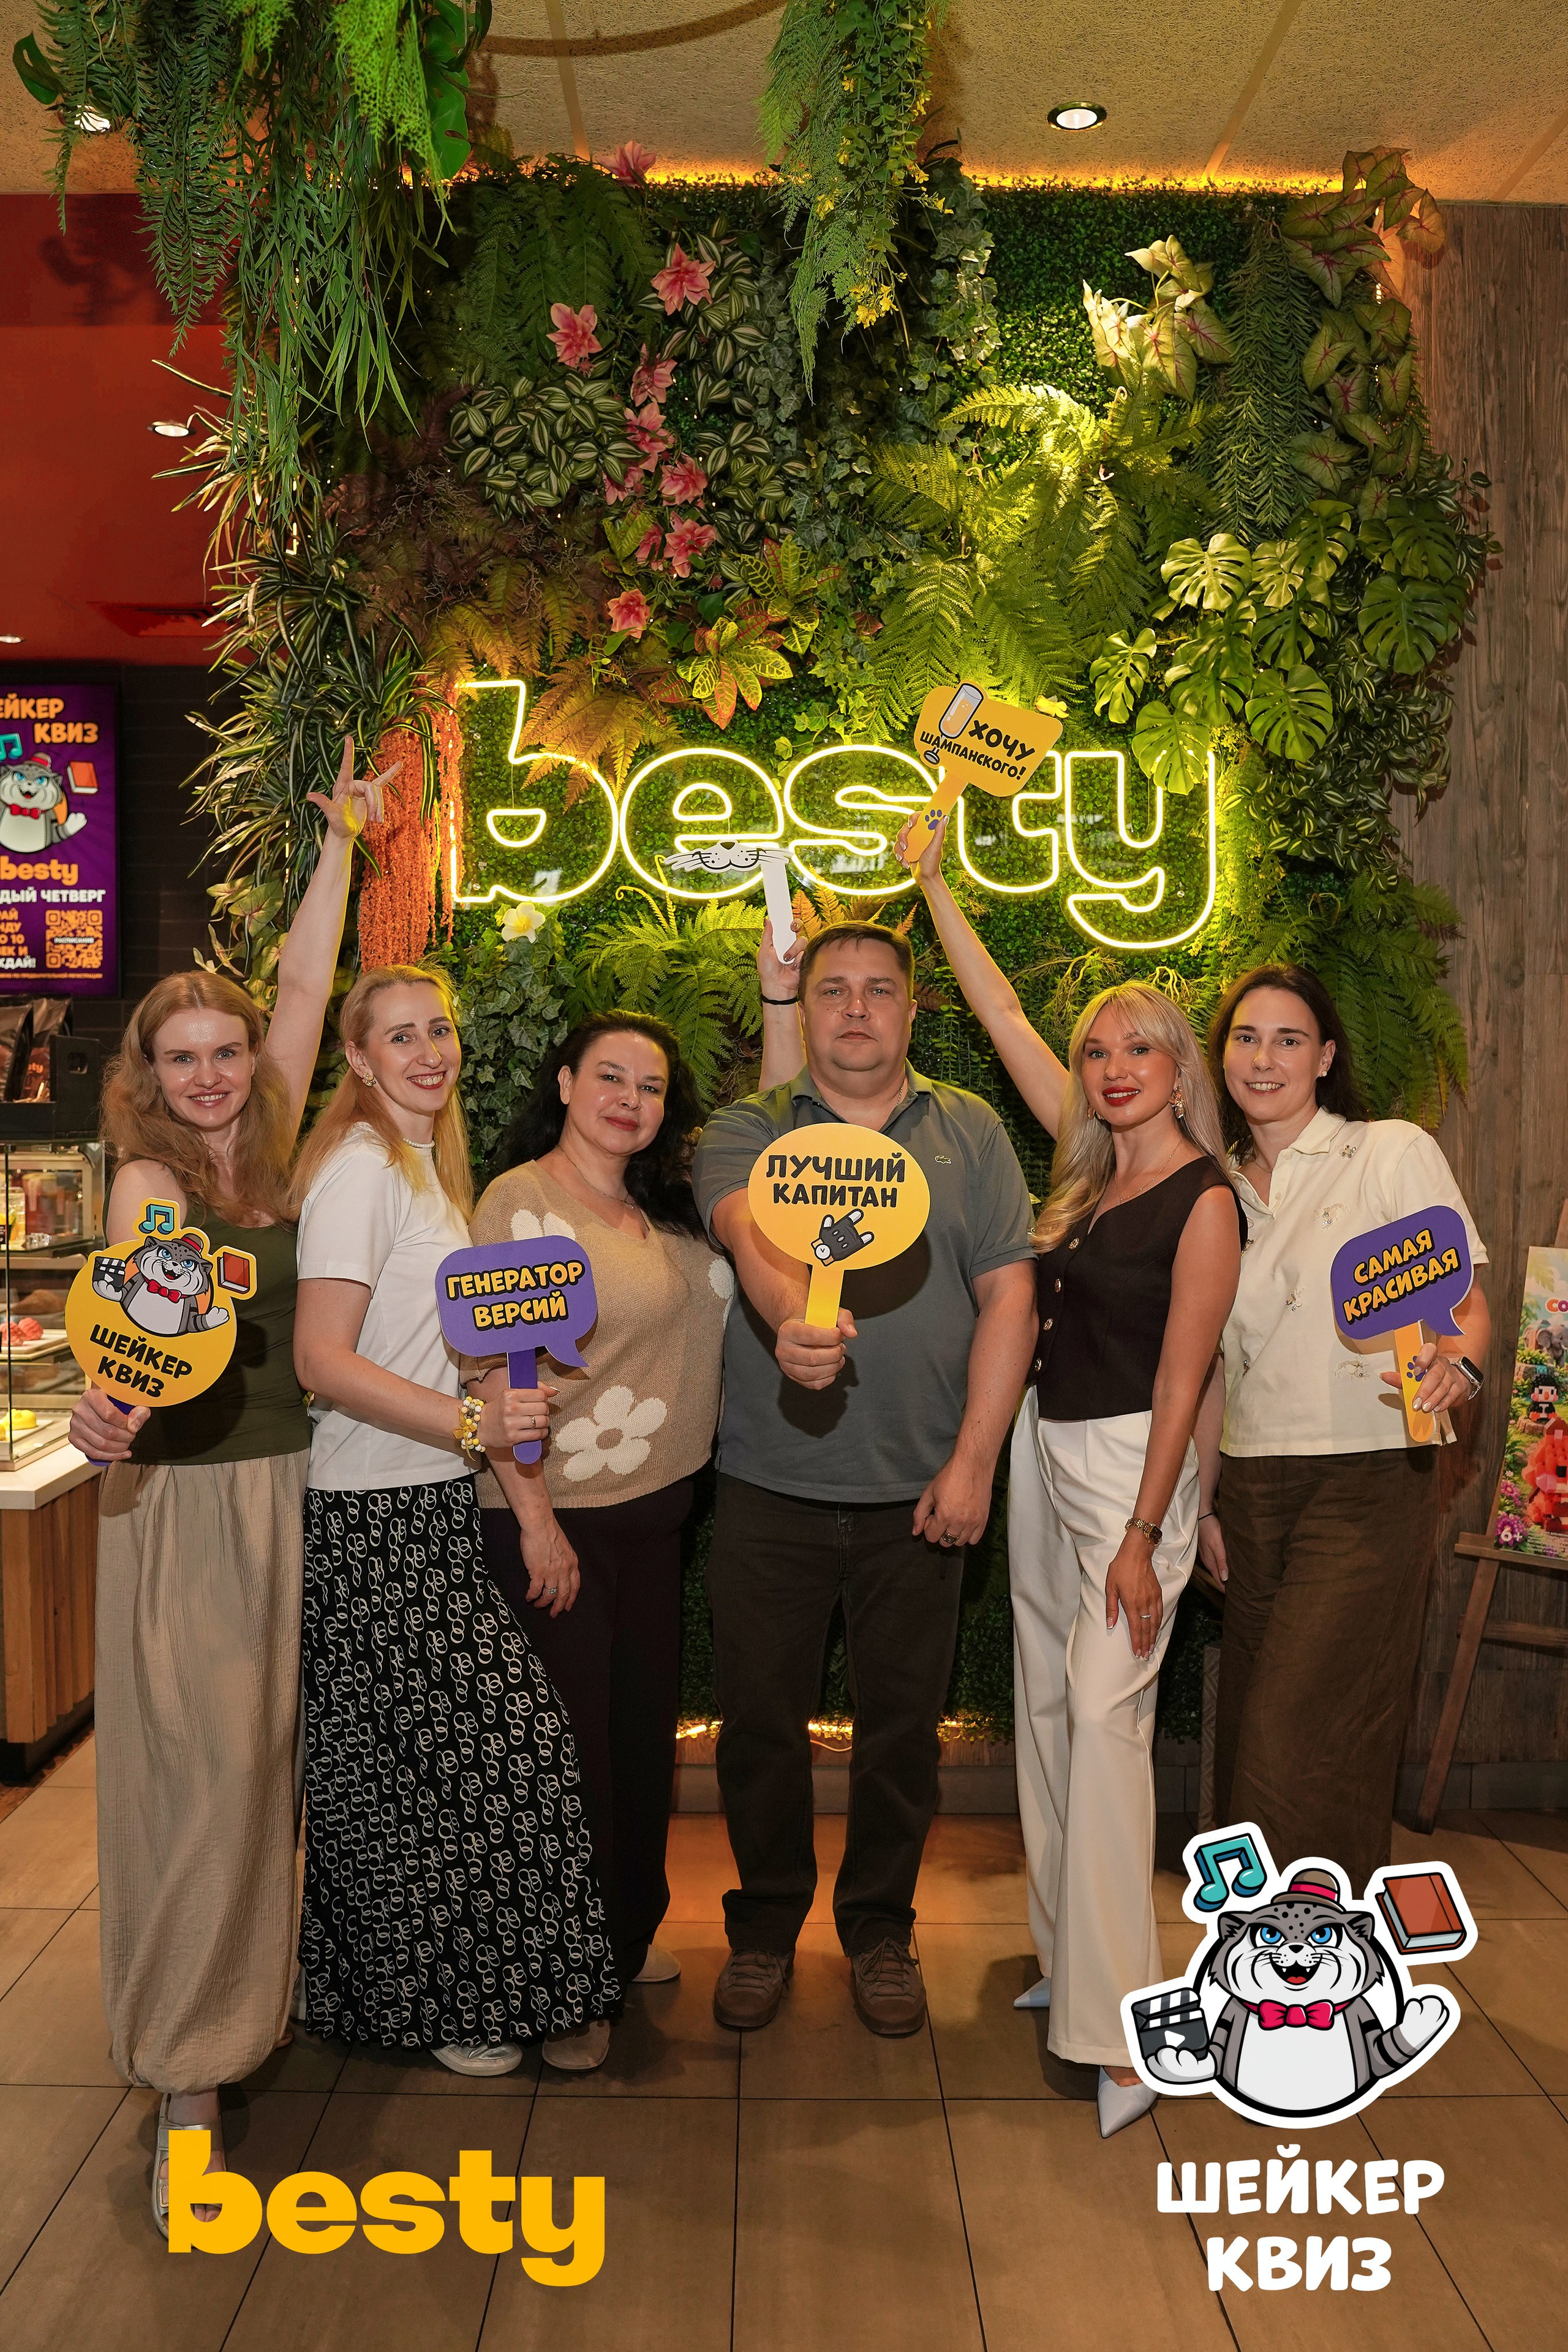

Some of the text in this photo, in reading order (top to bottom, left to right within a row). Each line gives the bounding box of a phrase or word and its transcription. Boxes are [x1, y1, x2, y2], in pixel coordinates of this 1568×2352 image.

[34, 722, 99, 744] КВИЗ
[968, 720, 1035, 761] ХОЧУ
[920, 731, 1027, 780] ШАМПАНСКОГО!
[450, 679, 1216, 949] besty
[0, 855, 78, 886] besty
[0, 908, 18, 921] АЙ
[40, 889, 106, 903] ЧЕТВЕРГ
[10, 933, 25, 944] 10
[766, 1152, 905, 1183] ЛУЧШИЙ
[773, 1183, 898, 1208] КАПИТАН
[1354, 1229, 1433, 1284] САМАЯ
[447, 1261, 583, 1298] ГЕНЕРАТОР
[1343, 1248, 1459, 1322] КРАСИВАЯ
[473, 1291, 567, 1328] ВЕРСИЙ
[90, 1324, 192, 1379] ШЕЙКЕР
[97, 1355, 165, 1398] КВИЗ
[1501, 1525, 1523, 1542] 6+
